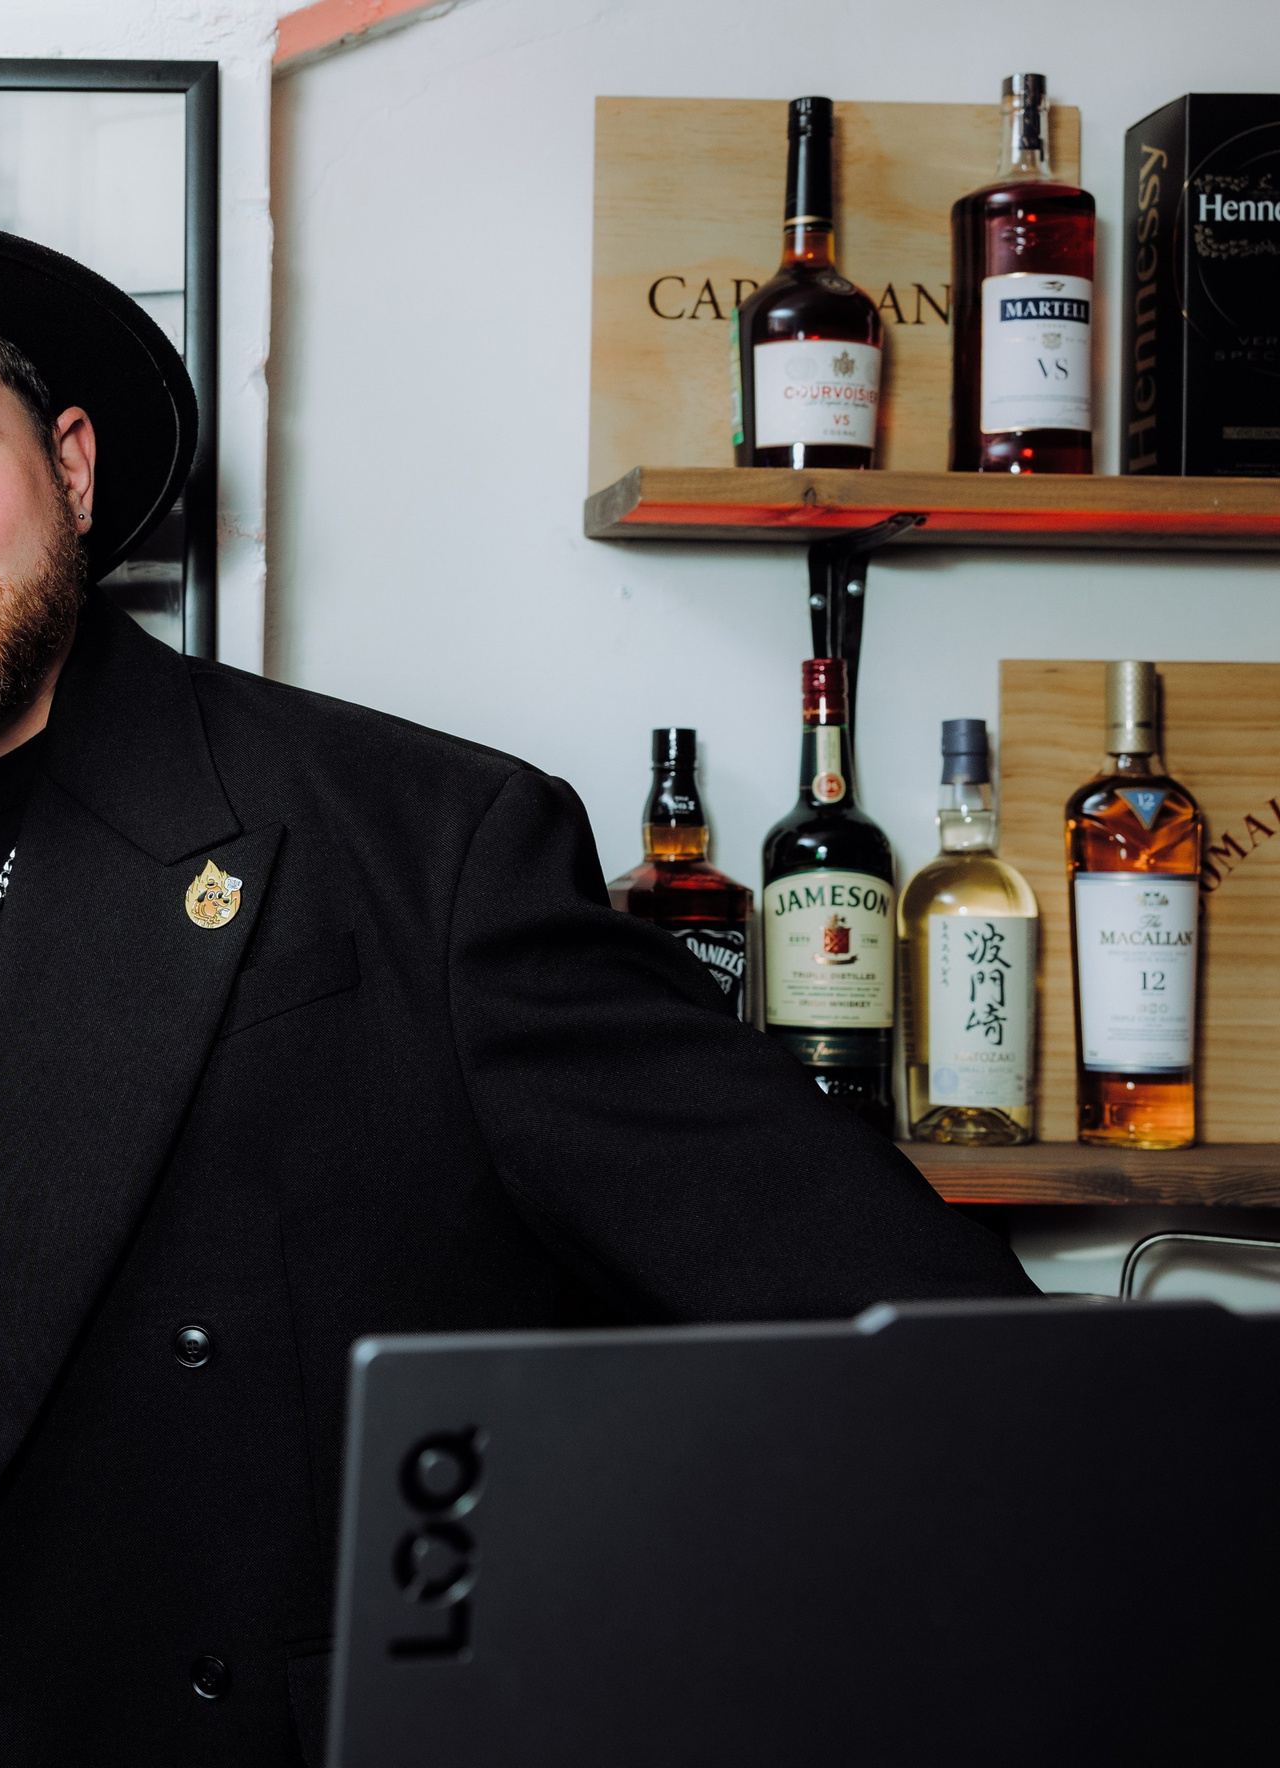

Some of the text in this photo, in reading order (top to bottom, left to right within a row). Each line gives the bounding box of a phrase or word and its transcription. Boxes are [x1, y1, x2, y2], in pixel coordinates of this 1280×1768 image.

[1005, 301, 1087, 320] MARTELL
[1127, 143, 1168, 472] Hennessy
[1037, 357, 1069, 381] VS
[833, 414, 851, 427] VS
[775, 885, 889, 917] JAMESON
[1100, 930, 1194, 946] MACALLAN
[1141, 970, 1166, 991] 12
